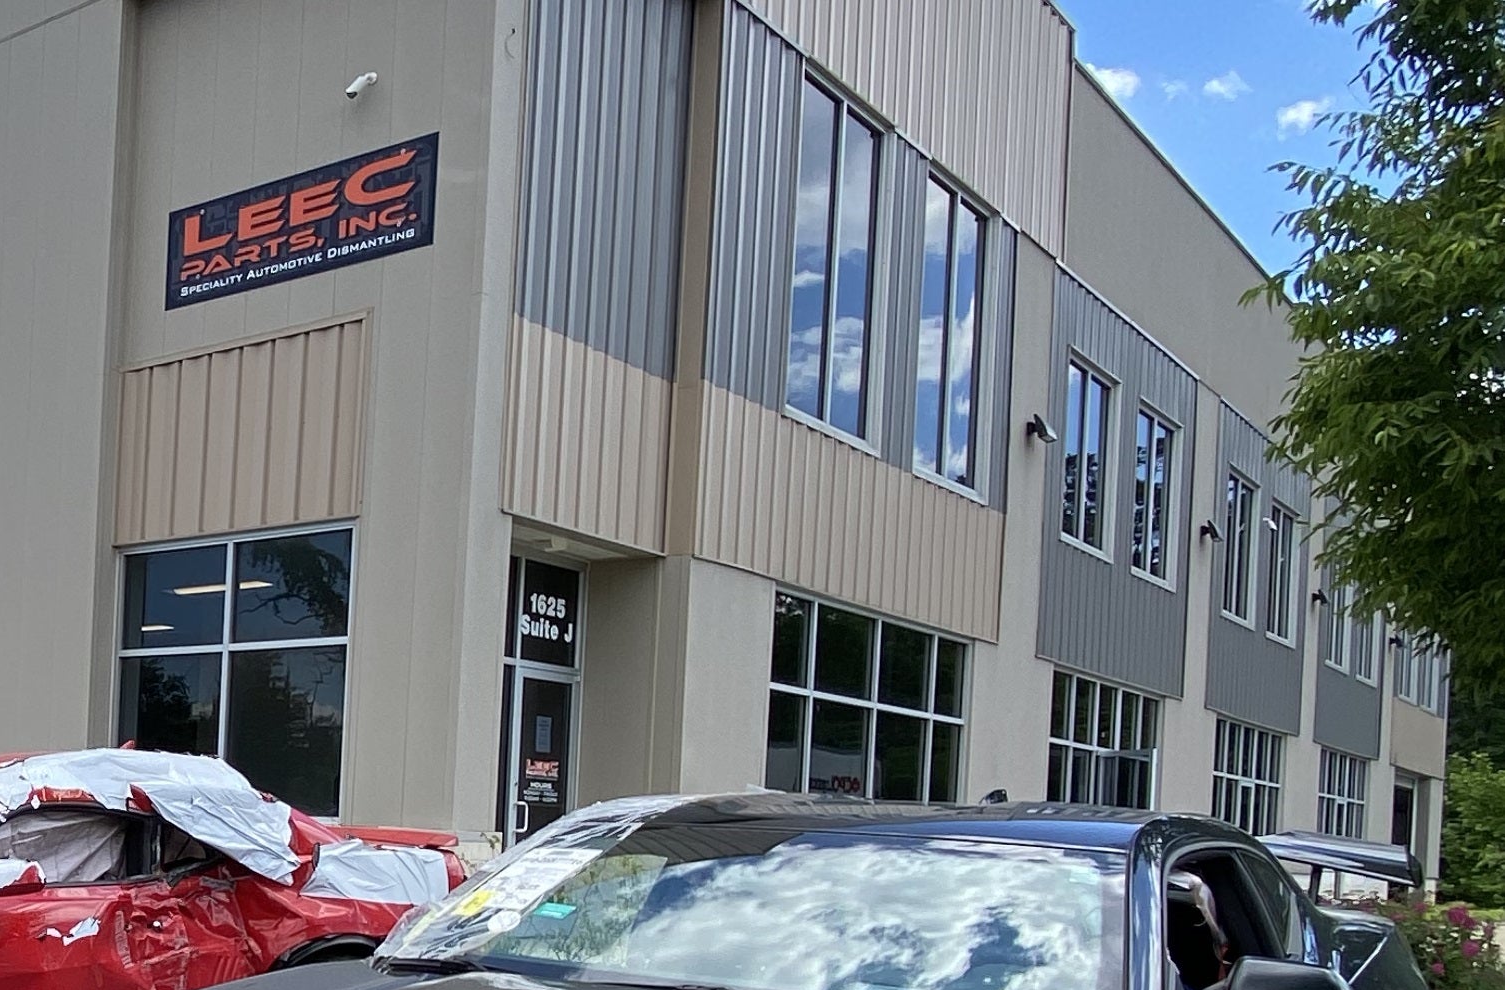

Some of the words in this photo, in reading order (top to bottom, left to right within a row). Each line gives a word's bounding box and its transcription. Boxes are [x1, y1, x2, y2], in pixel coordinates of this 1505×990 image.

[183, 149, 417, 257] LEEC
[180, 228, 325, 282] PARTS,
[338, 202, 417, 240] INC.
[180, 273, 243, 297] SPECIALITY
[246, 252, 323, 281] AUTOMOTIVE
[327, 228, 415, 259] DISMANTLING
[520, 614, 559, 640] Suite
[564, 623, 573, 643] J
[530, 593, 566, 619] 1625
